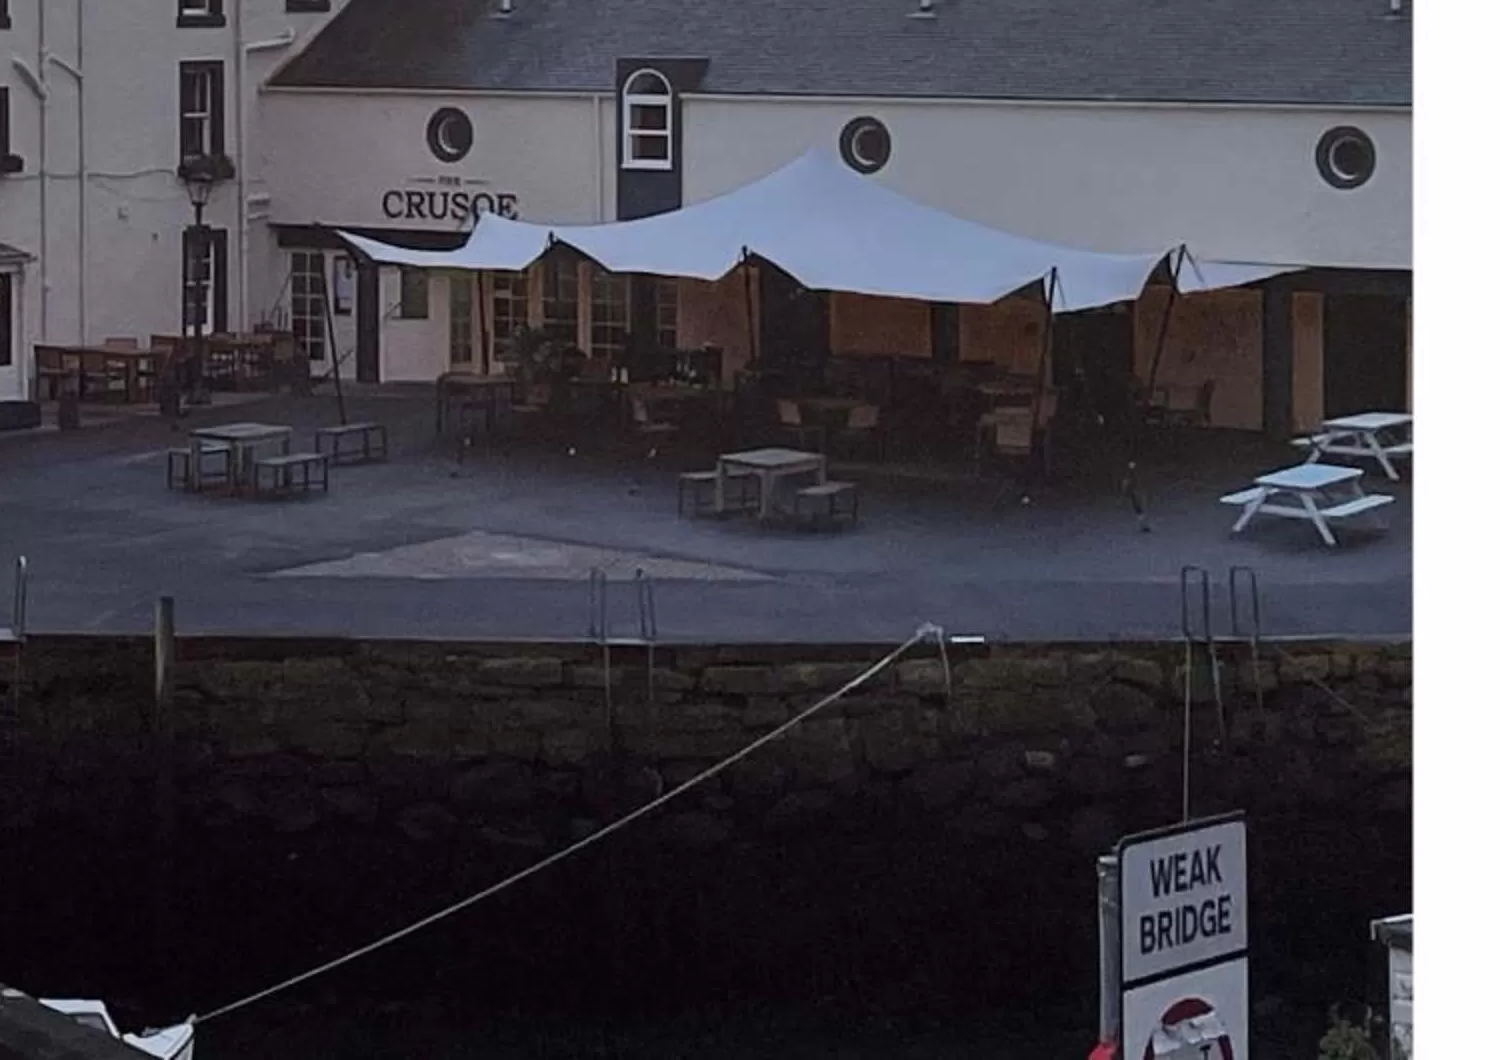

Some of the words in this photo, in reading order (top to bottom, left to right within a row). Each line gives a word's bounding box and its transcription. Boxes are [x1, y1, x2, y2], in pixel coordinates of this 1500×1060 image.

[382, 191, 518, 221] CRUSOE
[1150, 844, 1222, 897] WEAK
[1140, 895, 1232, 955] BRIDGE
